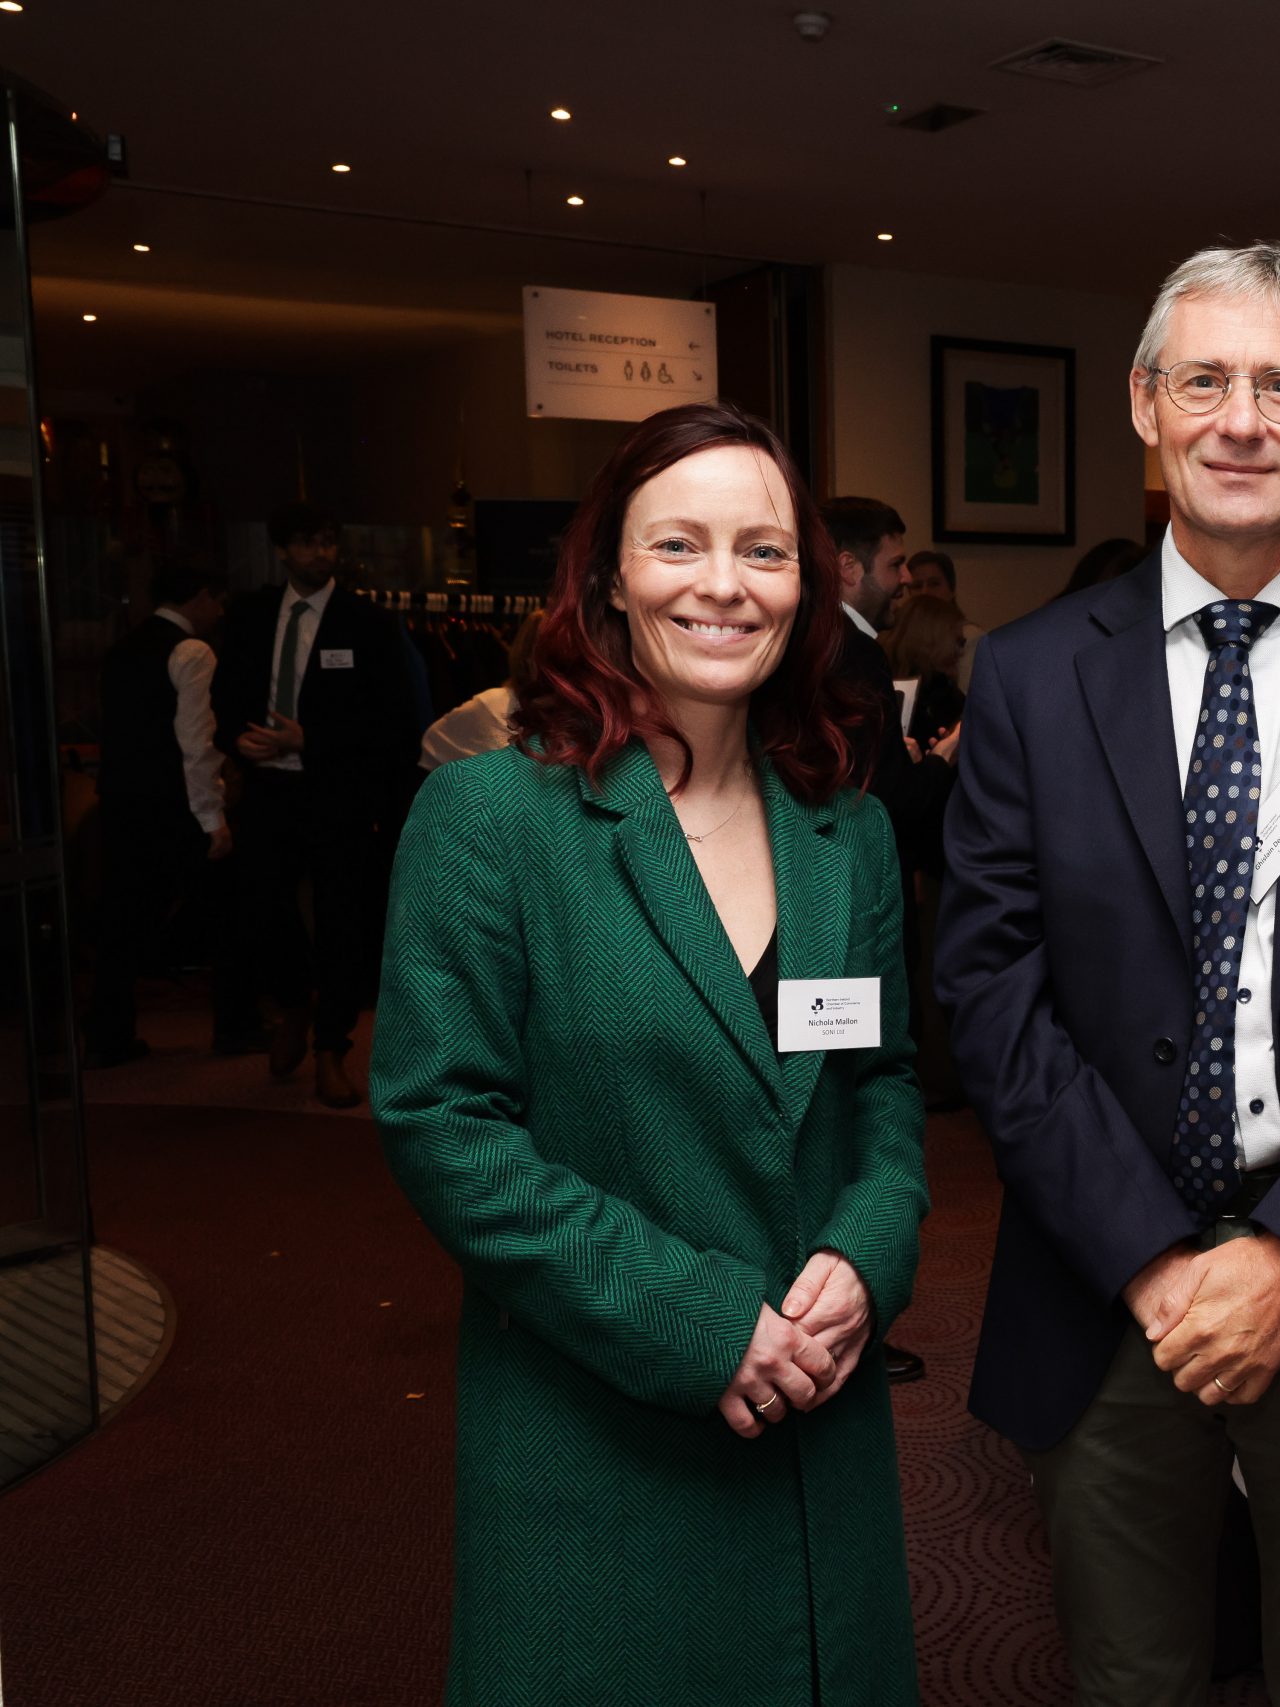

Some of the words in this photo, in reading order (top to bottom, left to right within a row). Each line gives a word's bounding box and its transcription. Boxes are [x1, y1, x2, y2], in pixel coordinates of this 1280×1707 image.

[545, 330, 585, 342] HOTEL
[589, 333, 657, 347] RECEPTION
[548, 361, 598, 374] TOILETS
[1255, 847, 1274, 871] Ghislain
[808, 1019, 834, 1027] Nichola
